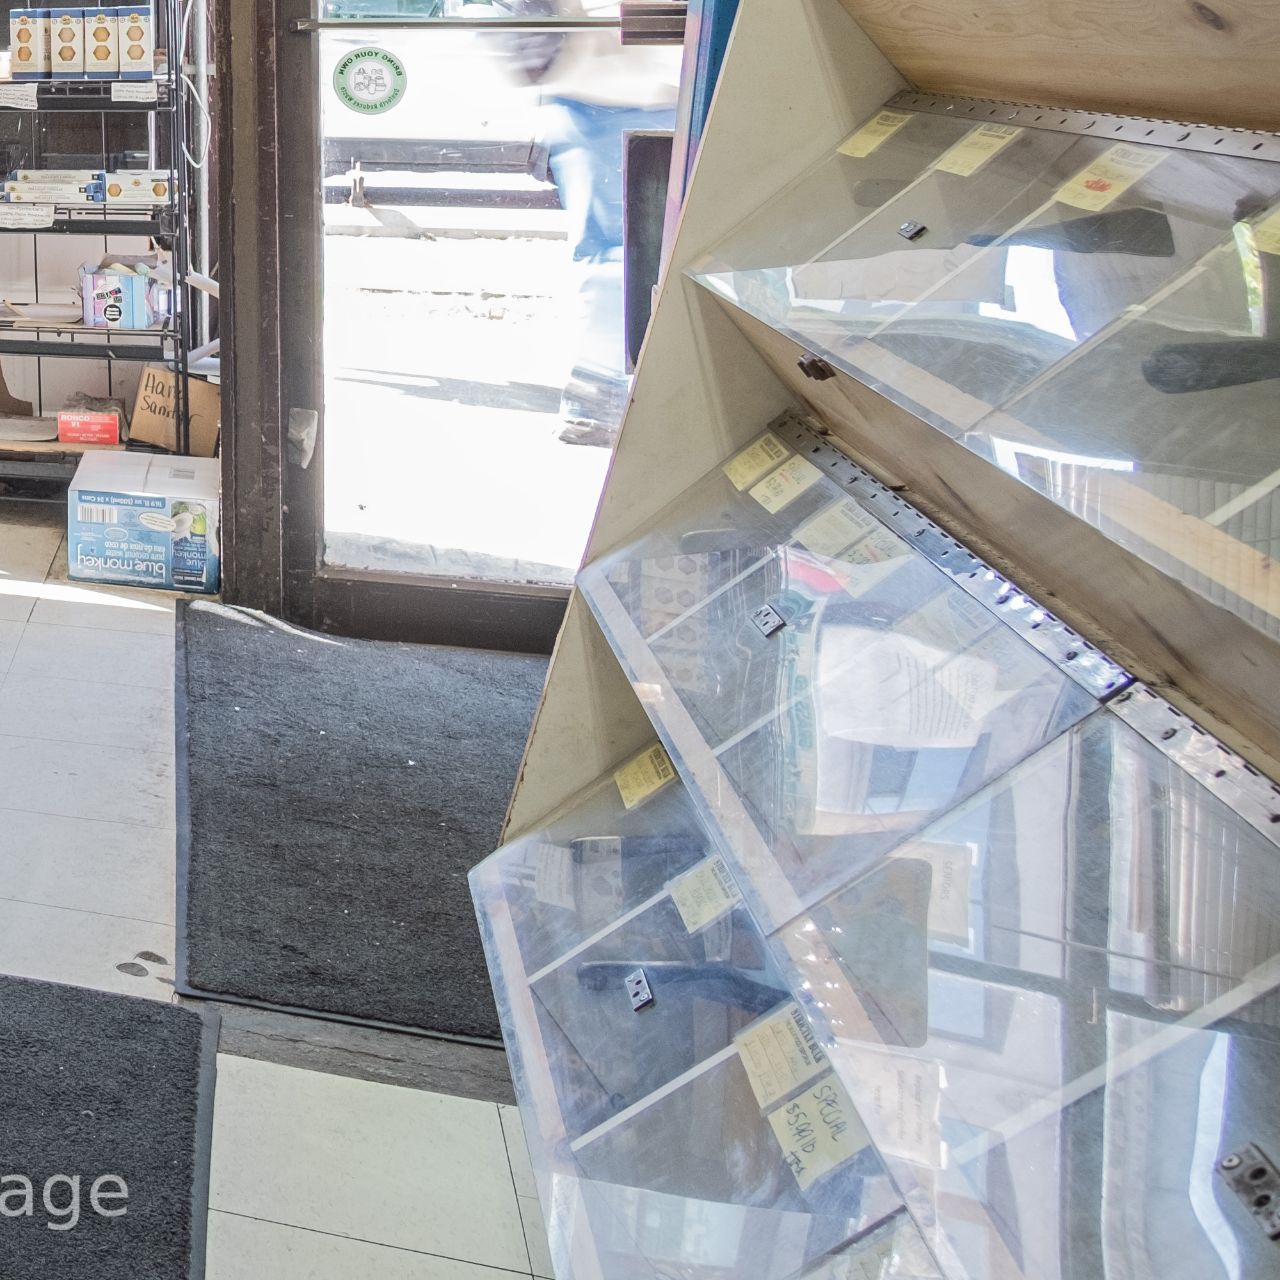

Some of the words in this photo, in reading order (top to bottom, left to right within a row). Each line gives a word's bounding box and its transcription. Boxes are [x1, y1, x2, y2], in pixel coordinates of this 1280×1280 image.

[77, 543, 133, 570] monkey
[125, 551, 150, 560] coconut
[134, 558, 166, 579] blue
[813, 1084, 848, 1143] SPECIAL
